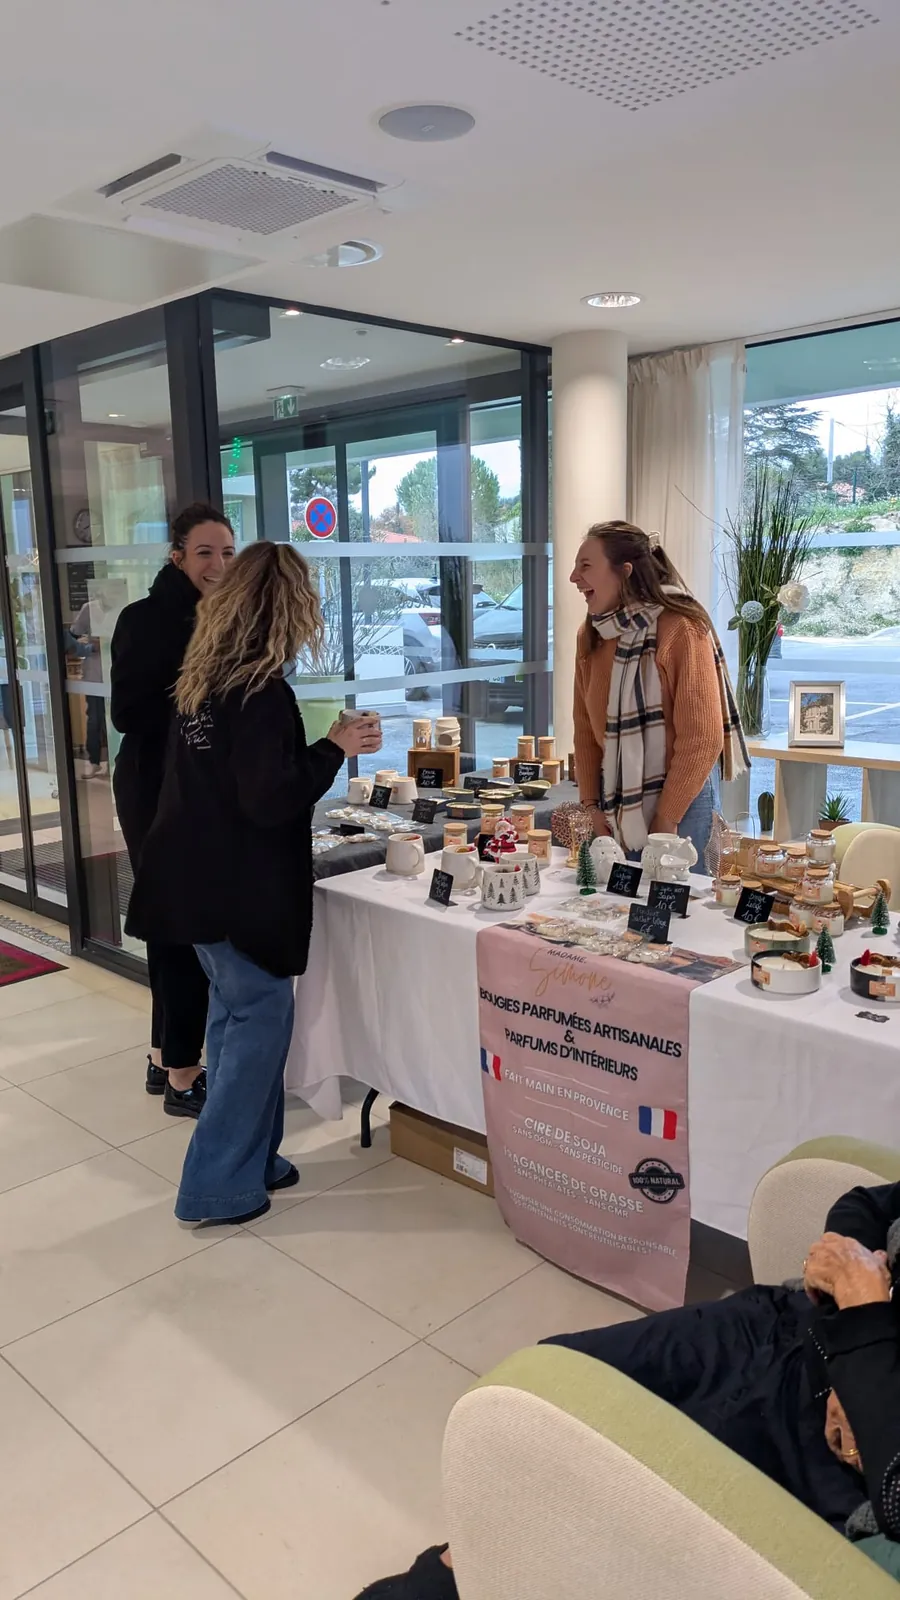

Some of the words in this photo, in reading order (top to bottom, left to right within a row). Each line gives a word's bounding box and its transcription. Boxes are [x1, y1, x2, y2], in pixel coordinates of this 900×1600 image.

[529, 946, 612, 997] Simone
[480, 987, 520, 1014] BOUGIES
[522, 1002, 592, 1033] PARFUMÉES
[593, 1022, 682, 1058] ARTISANALES
[505, 1027, 558, 1056] PARFUMS
[564, 1029, 575, 1044] &
[504, 1068, 523, 1084] FAIT
[525, 1077, 555, 1096] MAIN
[557, 1086, 572, 1099] EN
[574, 1091, 630, 1121] PROVENCE
[512, 1125, 533, 1139] SANS
[533, 1134, 553, 1148] OGM
[560, 1144, 581, 1159] SANS
[582, 1152, 624, 1175] PESTICIDE
[524, 1117, 553, 1137] CIRE
[554, 1127, 571, 1144] DE
[573, 1134, 607, 1158] SOJA
[571, 1177, 587, 1194] DE
[589, 1186, 645, 1213] GRASSE
[632, 1176, 650, 1185] 100%
[650, 1176, 681, 1186] NATURAL
[540, 1201, 553, 1214] UNE
[554, 1207, 617, 1241] CONSOMMATION
[583, 1195, 606, 1211] SANS
[607, 1203, 629, 1218] CMR
[567, 1222, 588, 1236] SONT
